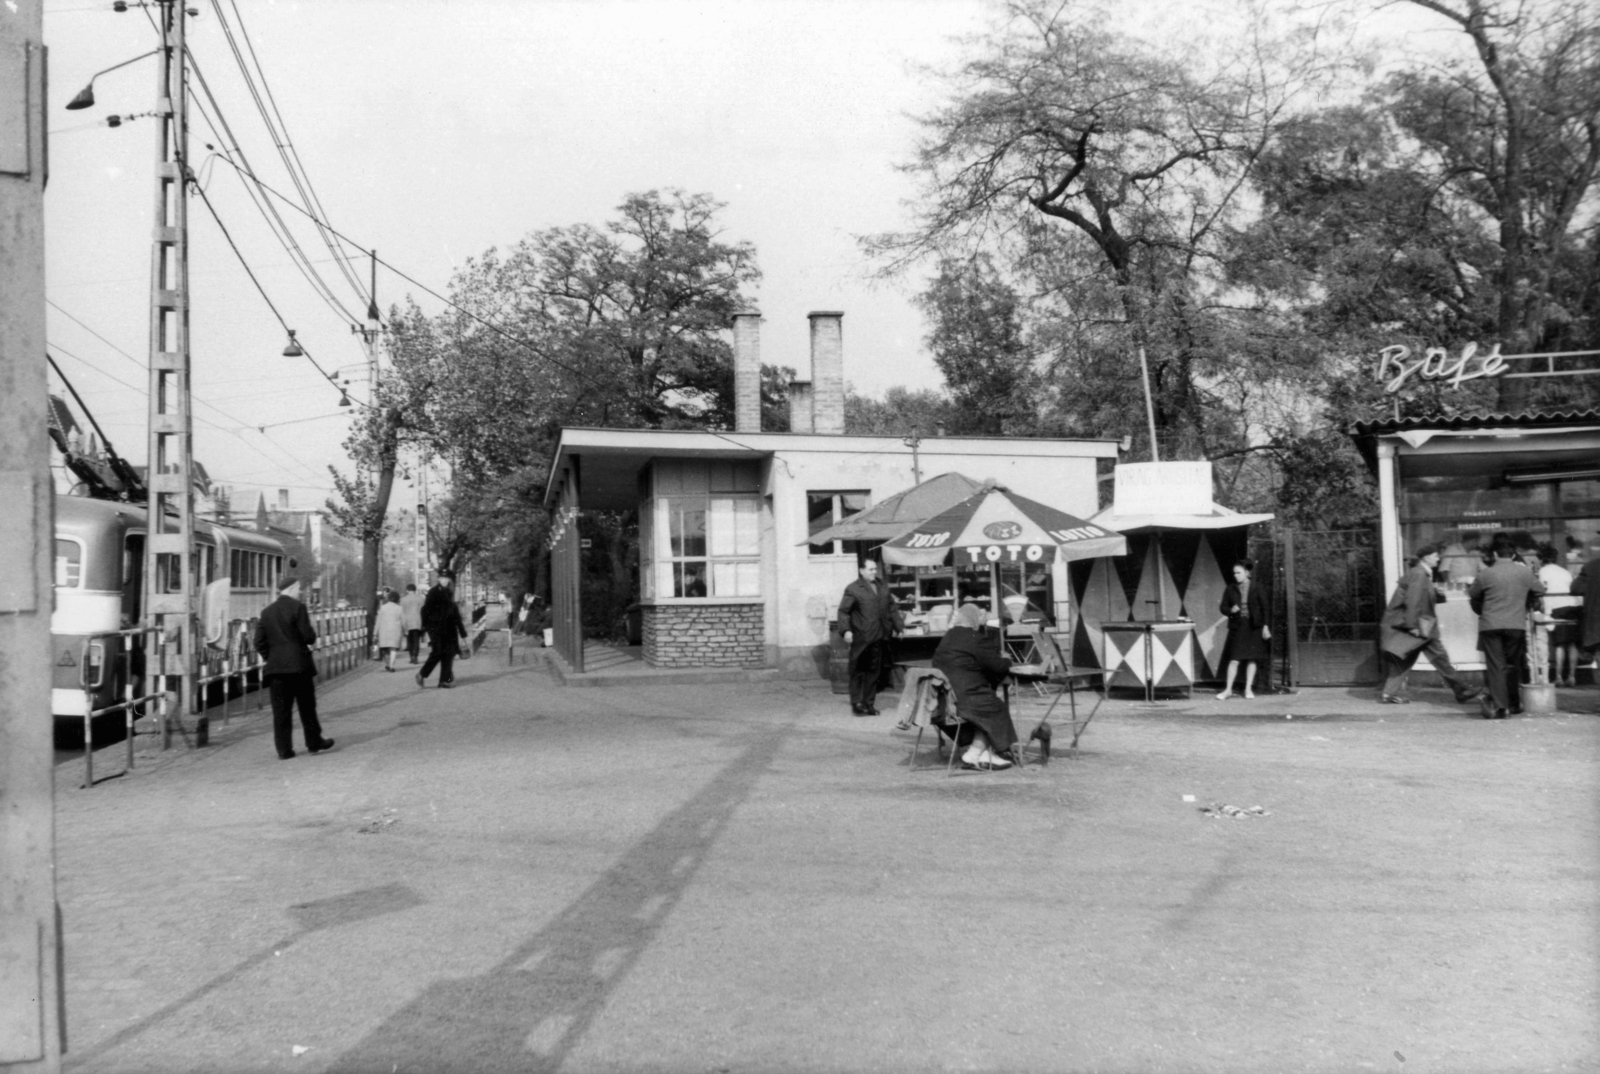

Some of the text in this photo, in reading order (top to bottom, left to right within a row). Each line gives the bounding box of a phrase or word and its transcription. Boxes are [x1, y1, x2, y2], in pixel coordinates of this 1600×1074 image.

[906, 531, 951, 548] TOTO
[1049, 526, 1105, 542] LOTTO
[966, 544, 1043, 563] TOTO
